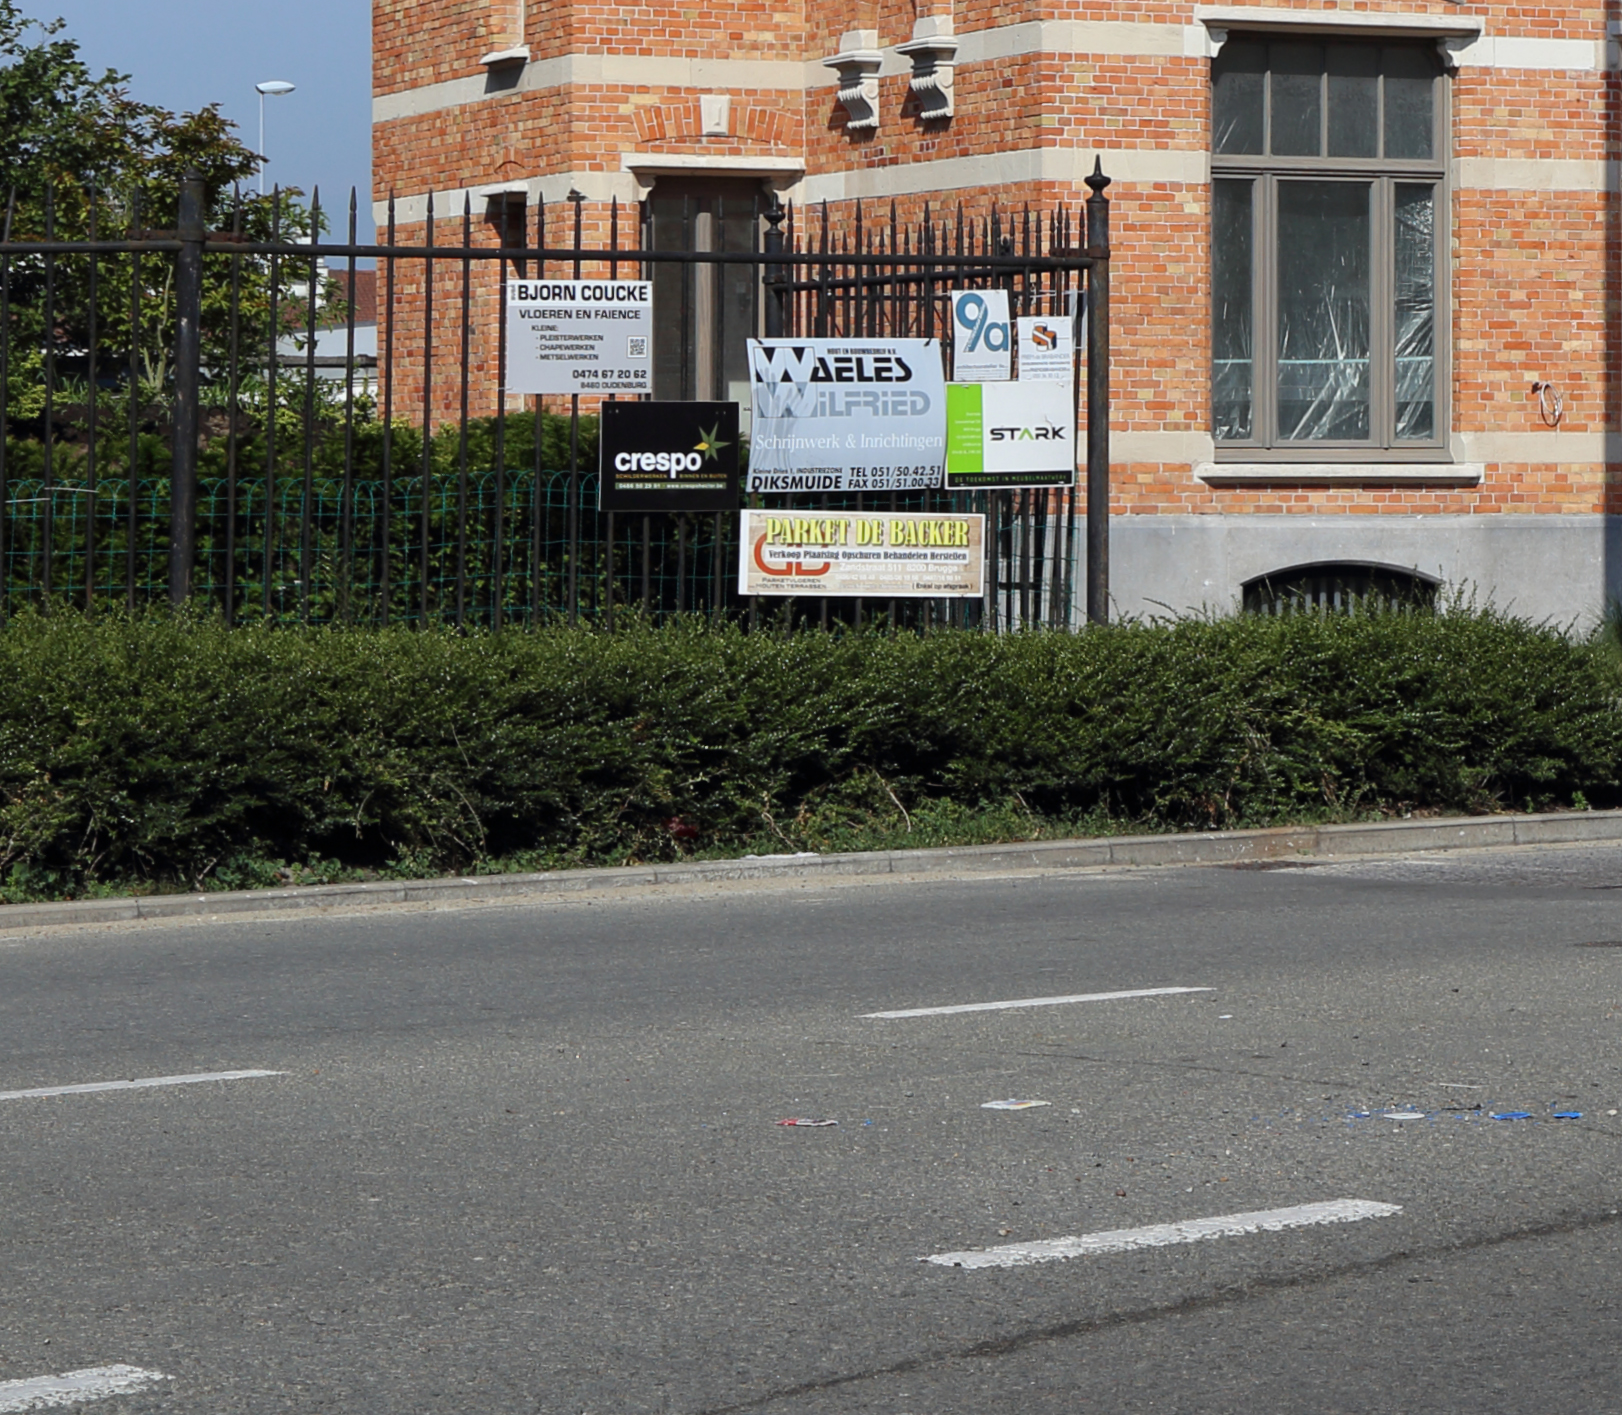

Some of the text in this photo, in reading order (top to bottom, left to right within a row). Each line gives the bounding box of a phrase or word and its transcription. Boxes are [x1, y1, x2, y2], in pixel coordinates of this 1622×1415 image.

[517, 284, 648, 302] BJORN COUCKE
[519, 309, 641, 319] VLOEREN EN FAIENCE
[572, 370, 647, 379] 0474 67 20 62
[990, 426, 1066, 441] STARK
[755, 432, 942, 453] Schrijnwerk & Inrichtingen
[615, 452, 702, 479] crespo
[850, 465, 941, 478] TEL 051/50.42.51
[751, 475, 843, 490] DIKSMUIDE
[848, 477, 940, 489] FAX 051/51.00.33
[765, 517, 970, 548] PARKET DE BACKER
[768, 550, 801, 559] Verkoop
[842, 551, 881, 560] Opschuren
